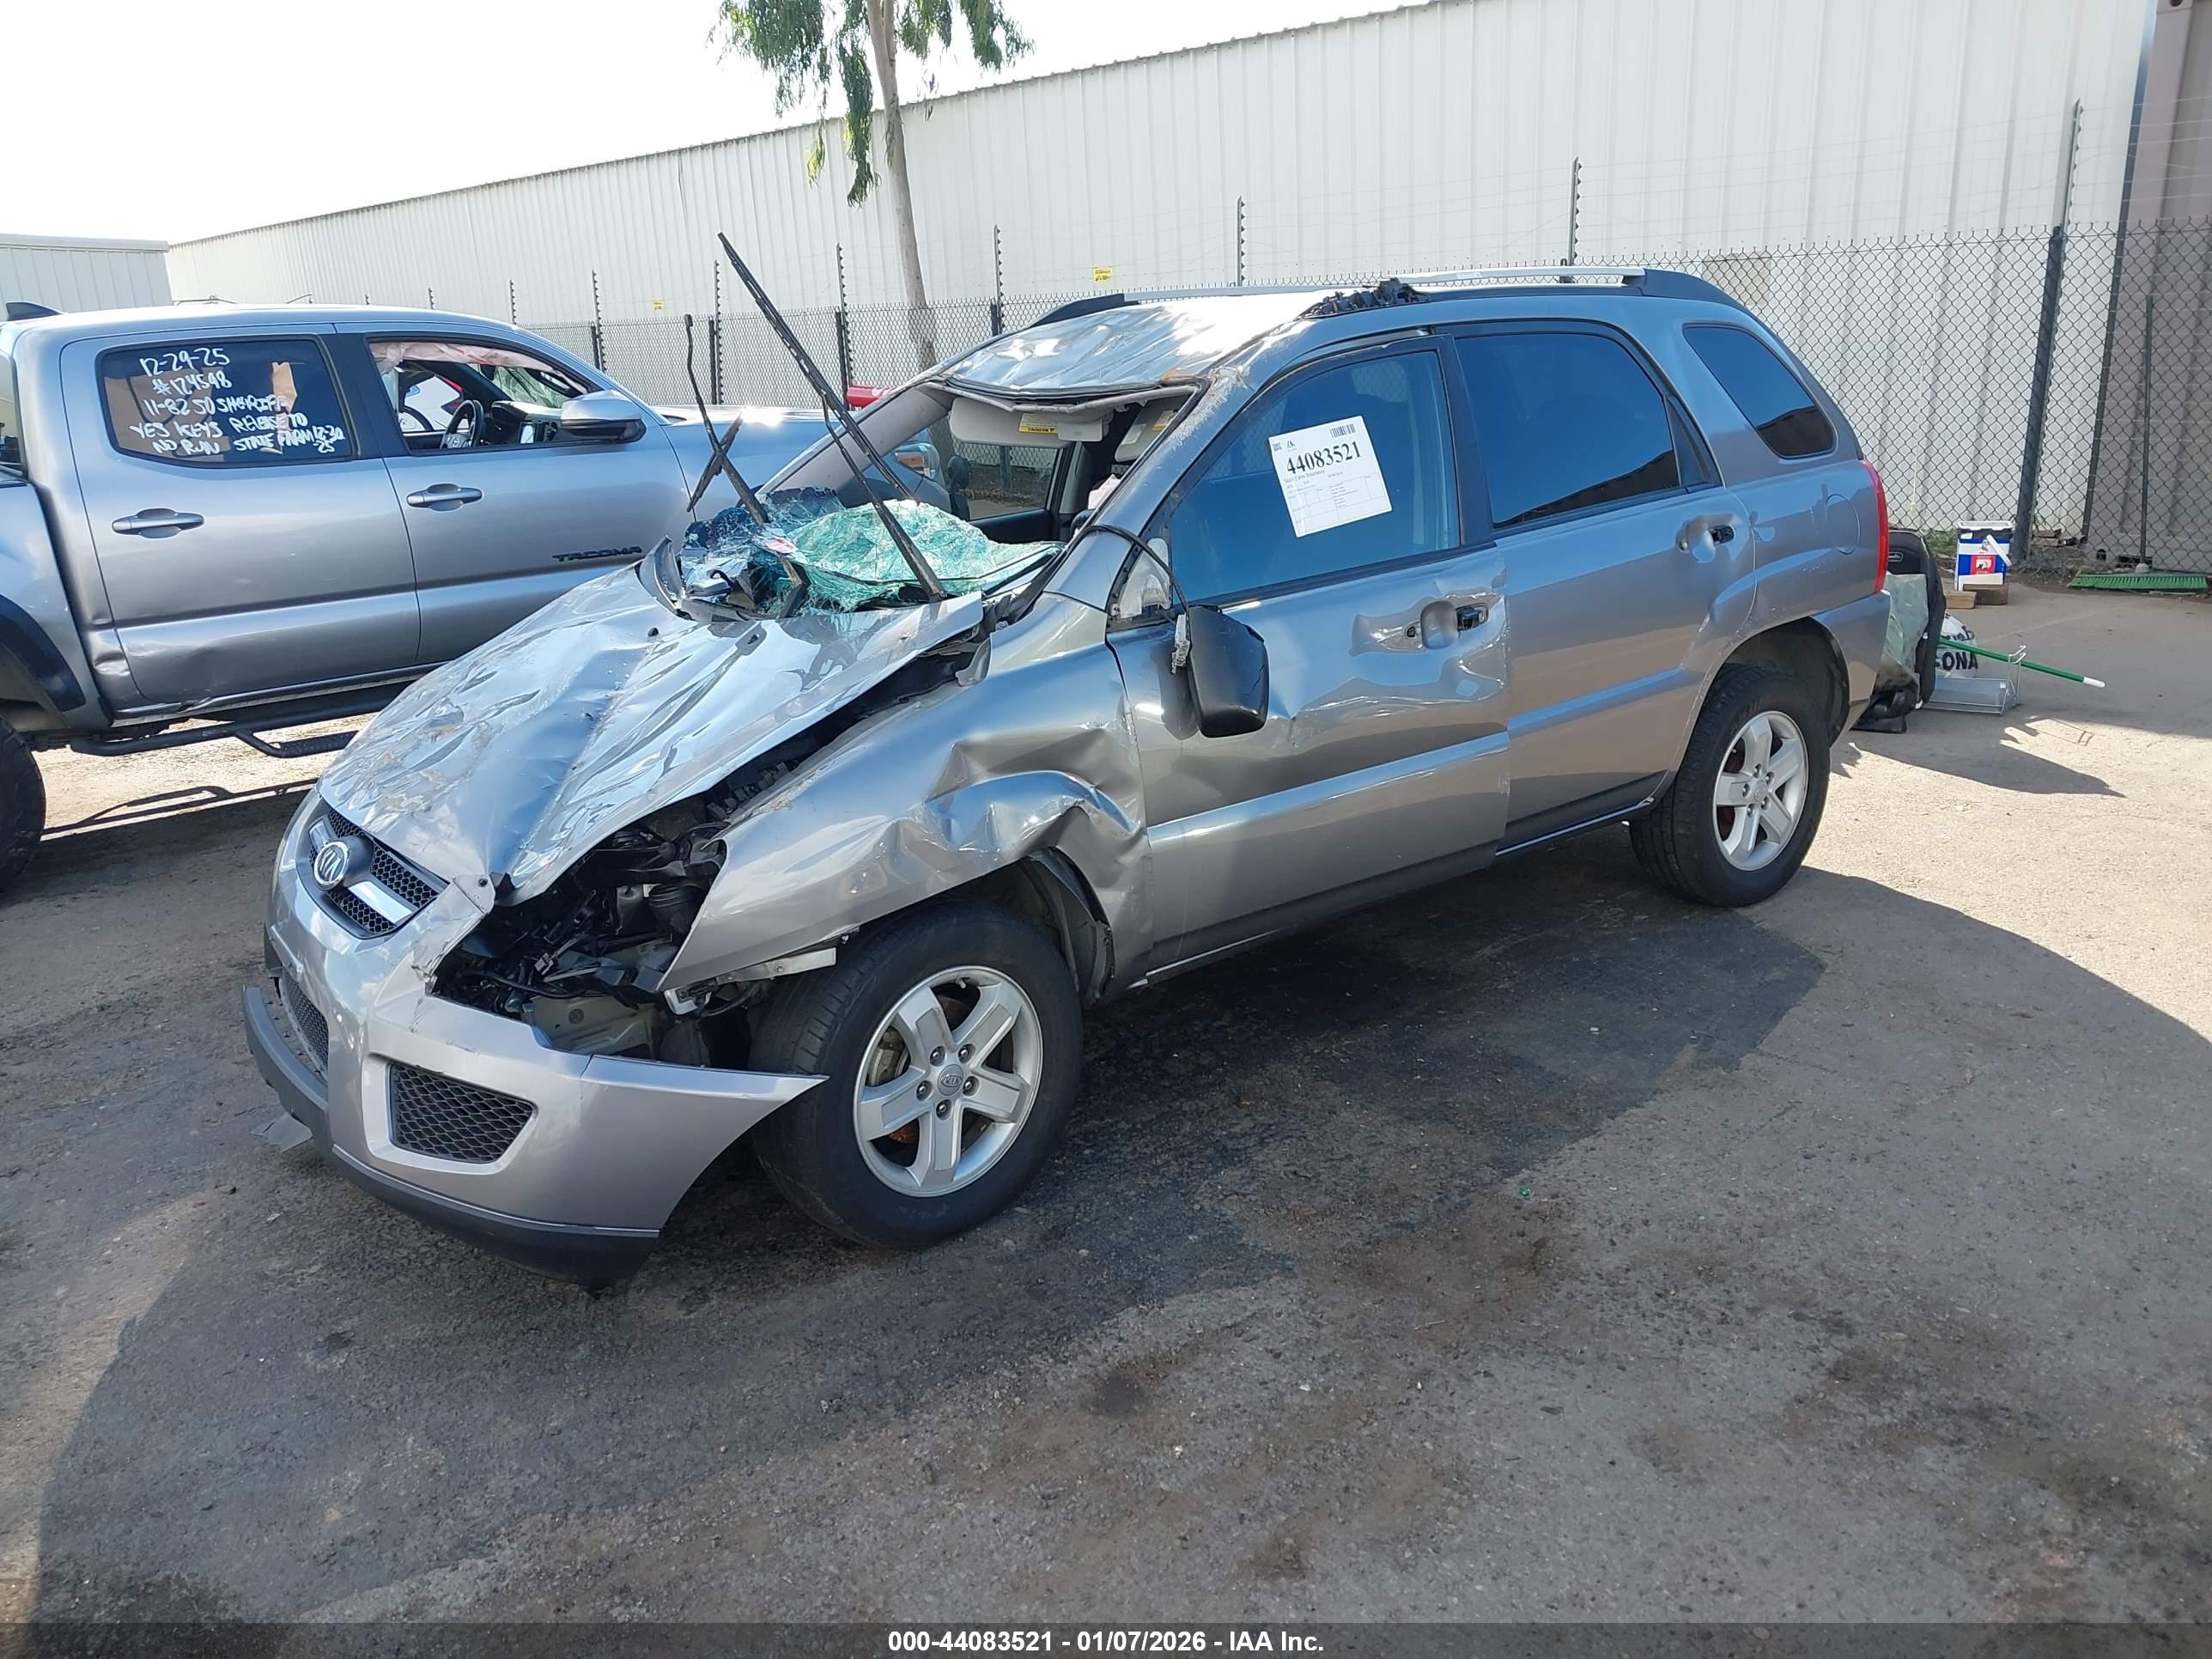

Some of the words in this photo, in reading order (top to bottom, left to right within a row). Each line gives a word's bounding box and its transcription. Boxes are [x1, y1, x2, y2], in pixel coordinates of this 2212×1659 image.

[139, 347, 230, 377] 12-29-25
[288, 412, 308, 428] TO
[129, 422, 170, 440] YES
[173, 421, 223, 438] KEYS
[233, 432, 275, 451] STATE
[276, 428, 314, 447] FARM
[152, 438, 178, 454] NO
[179, 438, 220, 455] RUN
[1286, 441, 1361, 475] 44083521
[551, 545, 643, 562] TACOMA
